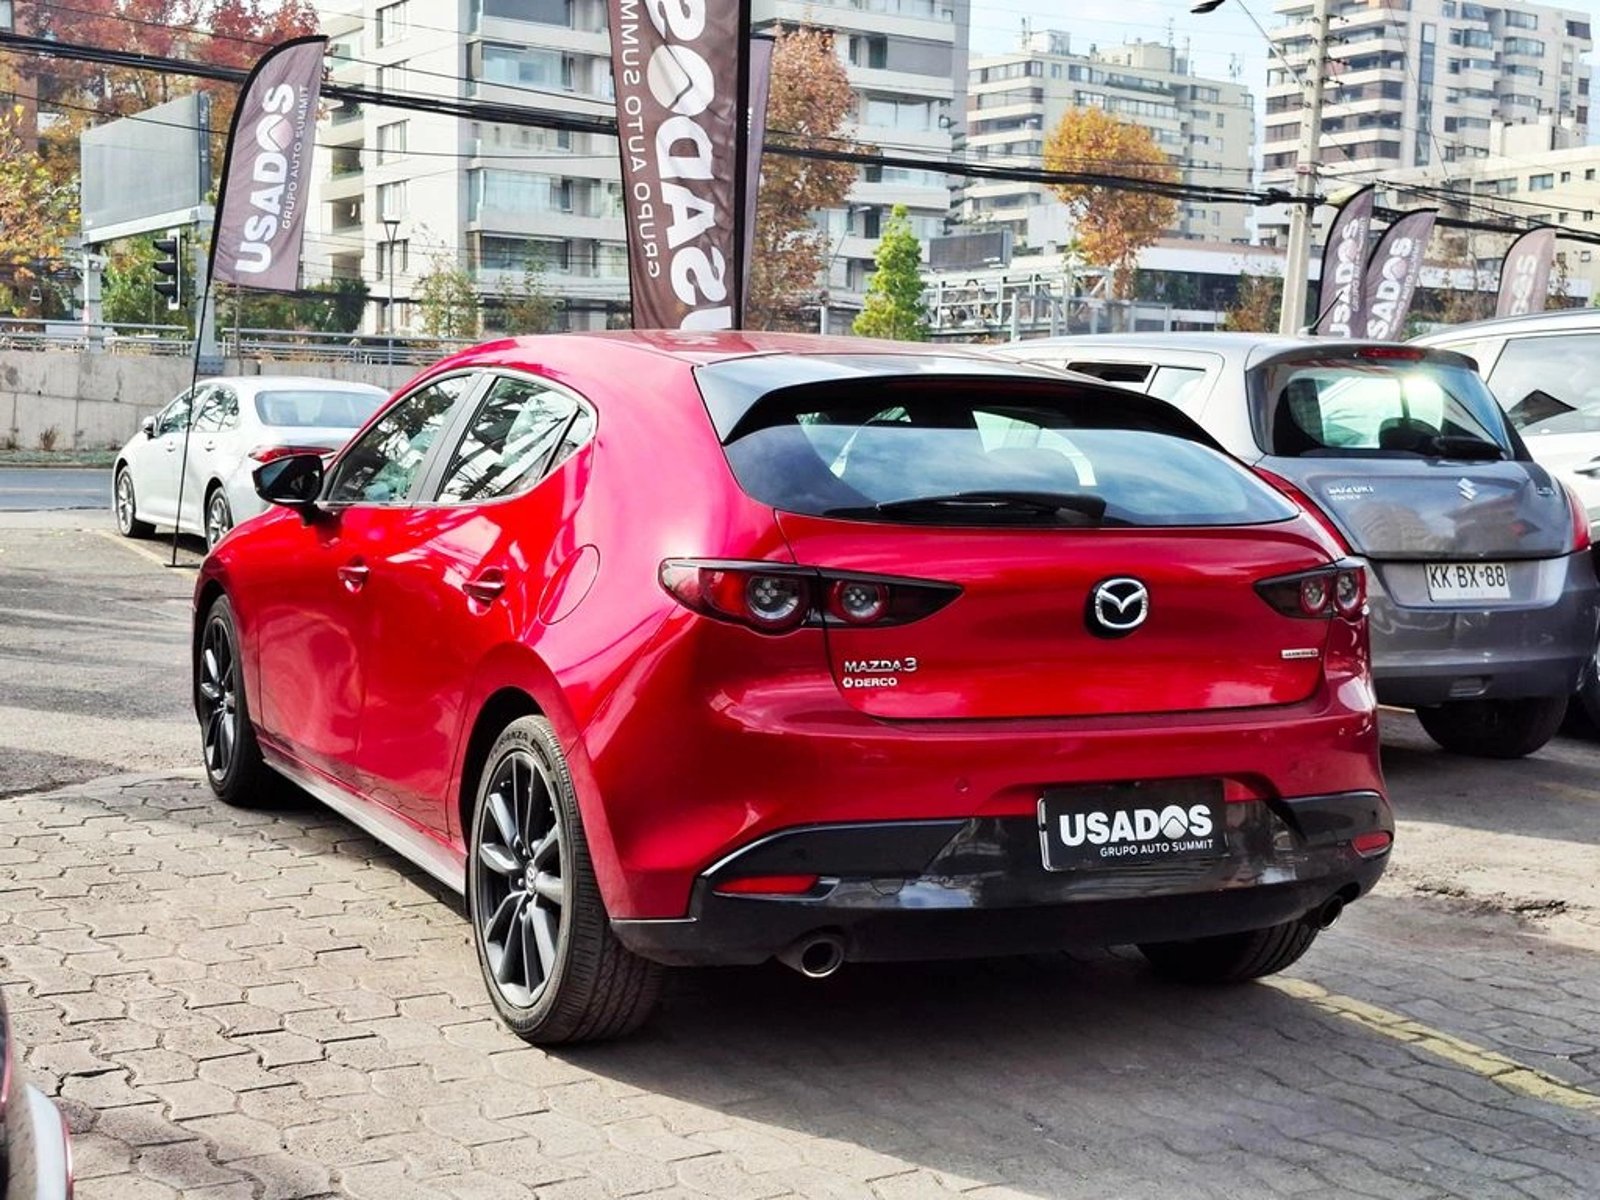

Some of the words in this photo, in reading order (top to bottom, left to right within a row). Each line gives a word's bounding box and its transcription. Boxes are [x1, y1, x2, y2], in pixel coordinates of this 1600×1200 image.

[297, 86, 309, 139] SUMMIT
[235, 83, 294, 273] USADOS
[292, 142, 303, 180] AUTO
[282, 183, 297, 229] GRUPO
[1367, 237, 1413, 339] SADOS
[854, 677, 898, 687] DERCO
[1059, 804, 1213, 846] USADOS
[1100, 845, 1138, 857] GRUPO
[1140, 843, 1170, 855] AUTO
[1172, 839, 1214, 852] SUMMIT
